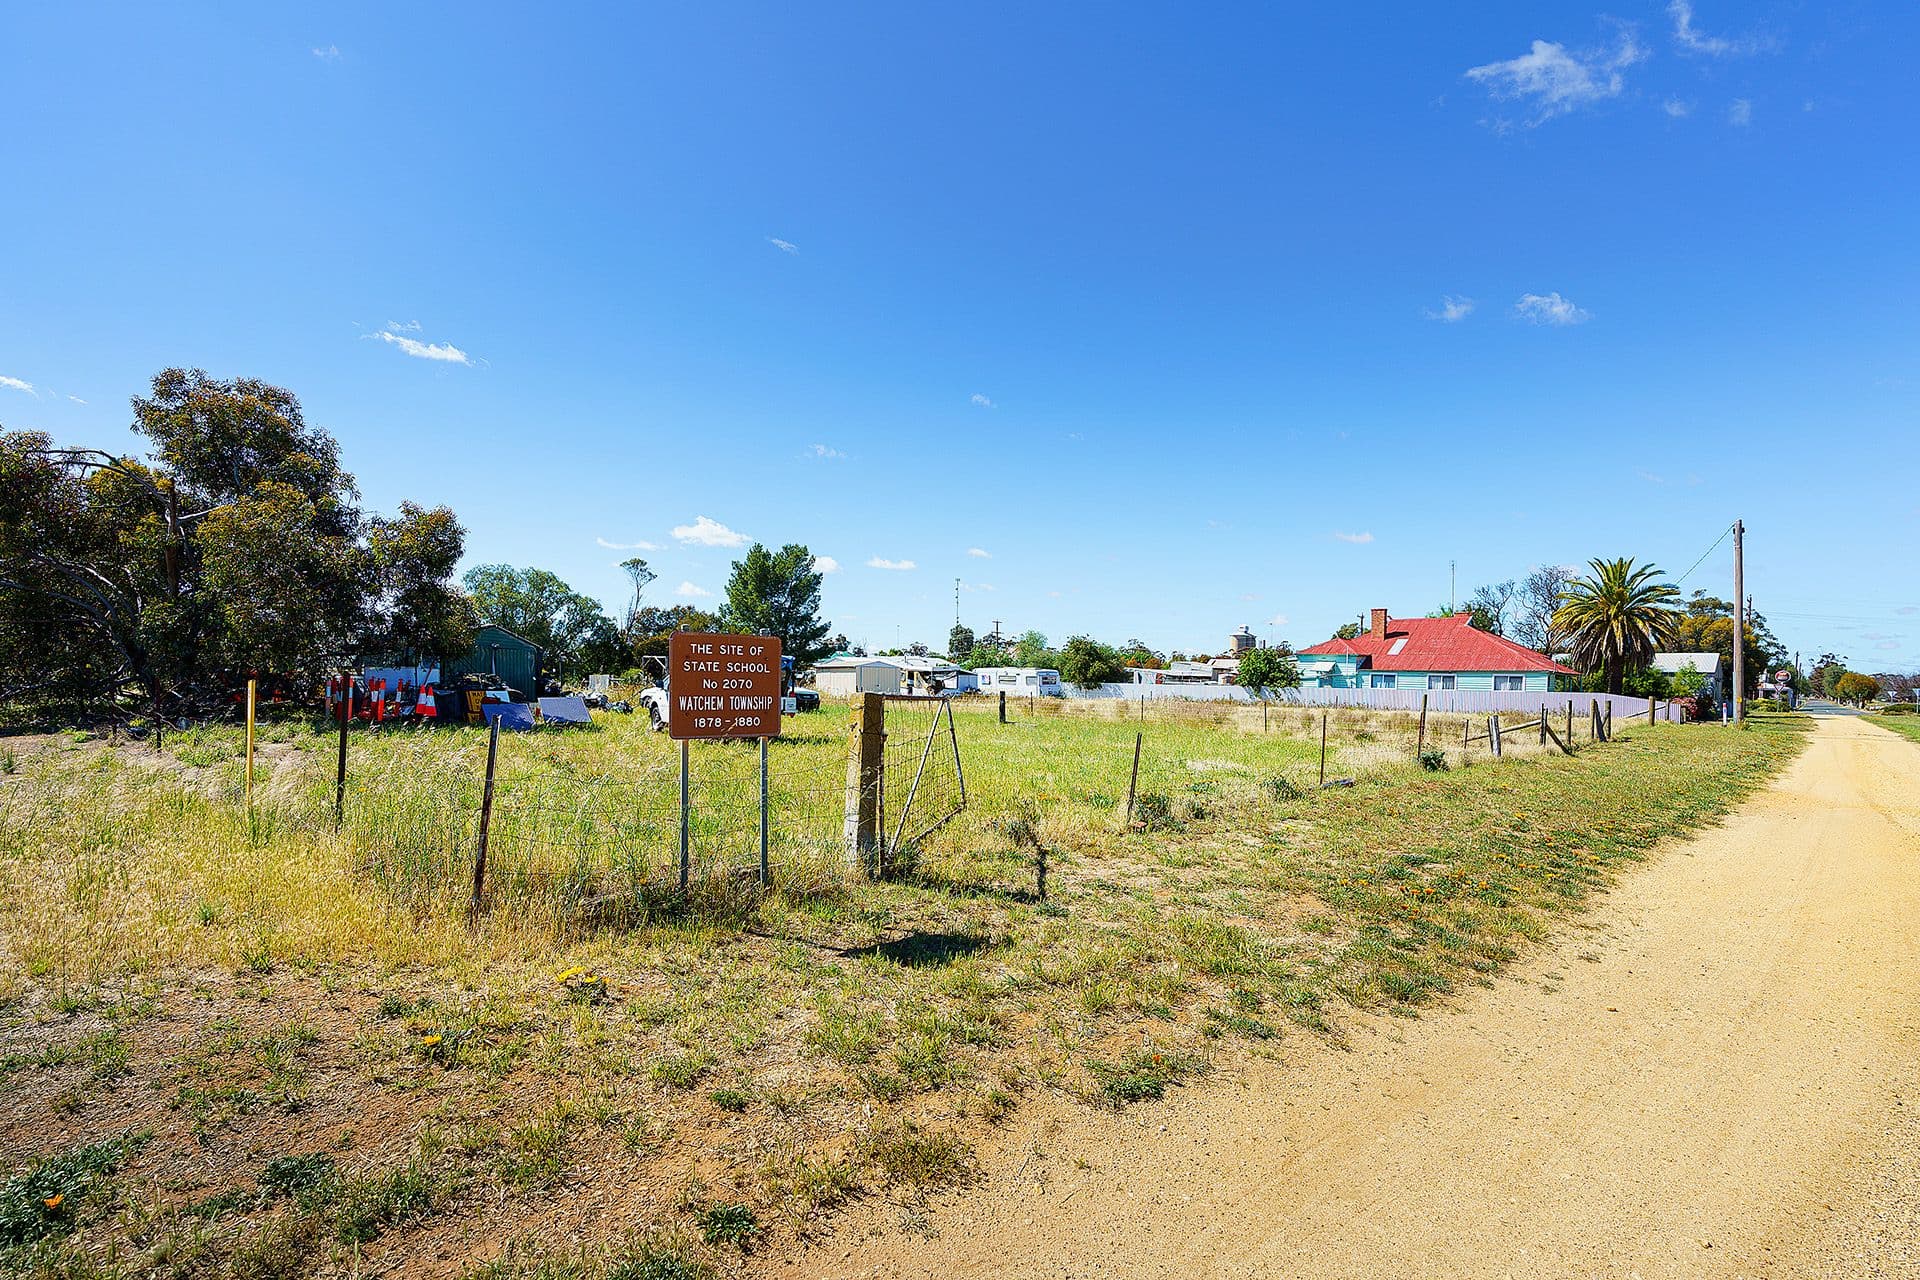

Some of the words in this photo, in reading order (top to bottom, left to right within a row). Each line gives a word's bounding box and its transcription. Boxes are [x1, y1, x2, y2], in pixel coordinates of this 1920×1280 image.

[690, 643, 713, 655] THE
[719, 644, 744, 656] SITE
[749, 646, 764, 656] OF
[683, 661, 720, 672] STATE
[726, 662, 771, 673] SCHOOL
[702, 679, 718, 689] No
[722, 679, 753, 689] 2070
[679, 695, 724, 711] WATCHEM
[729, 696, 773, 711] TOWNSHIP
